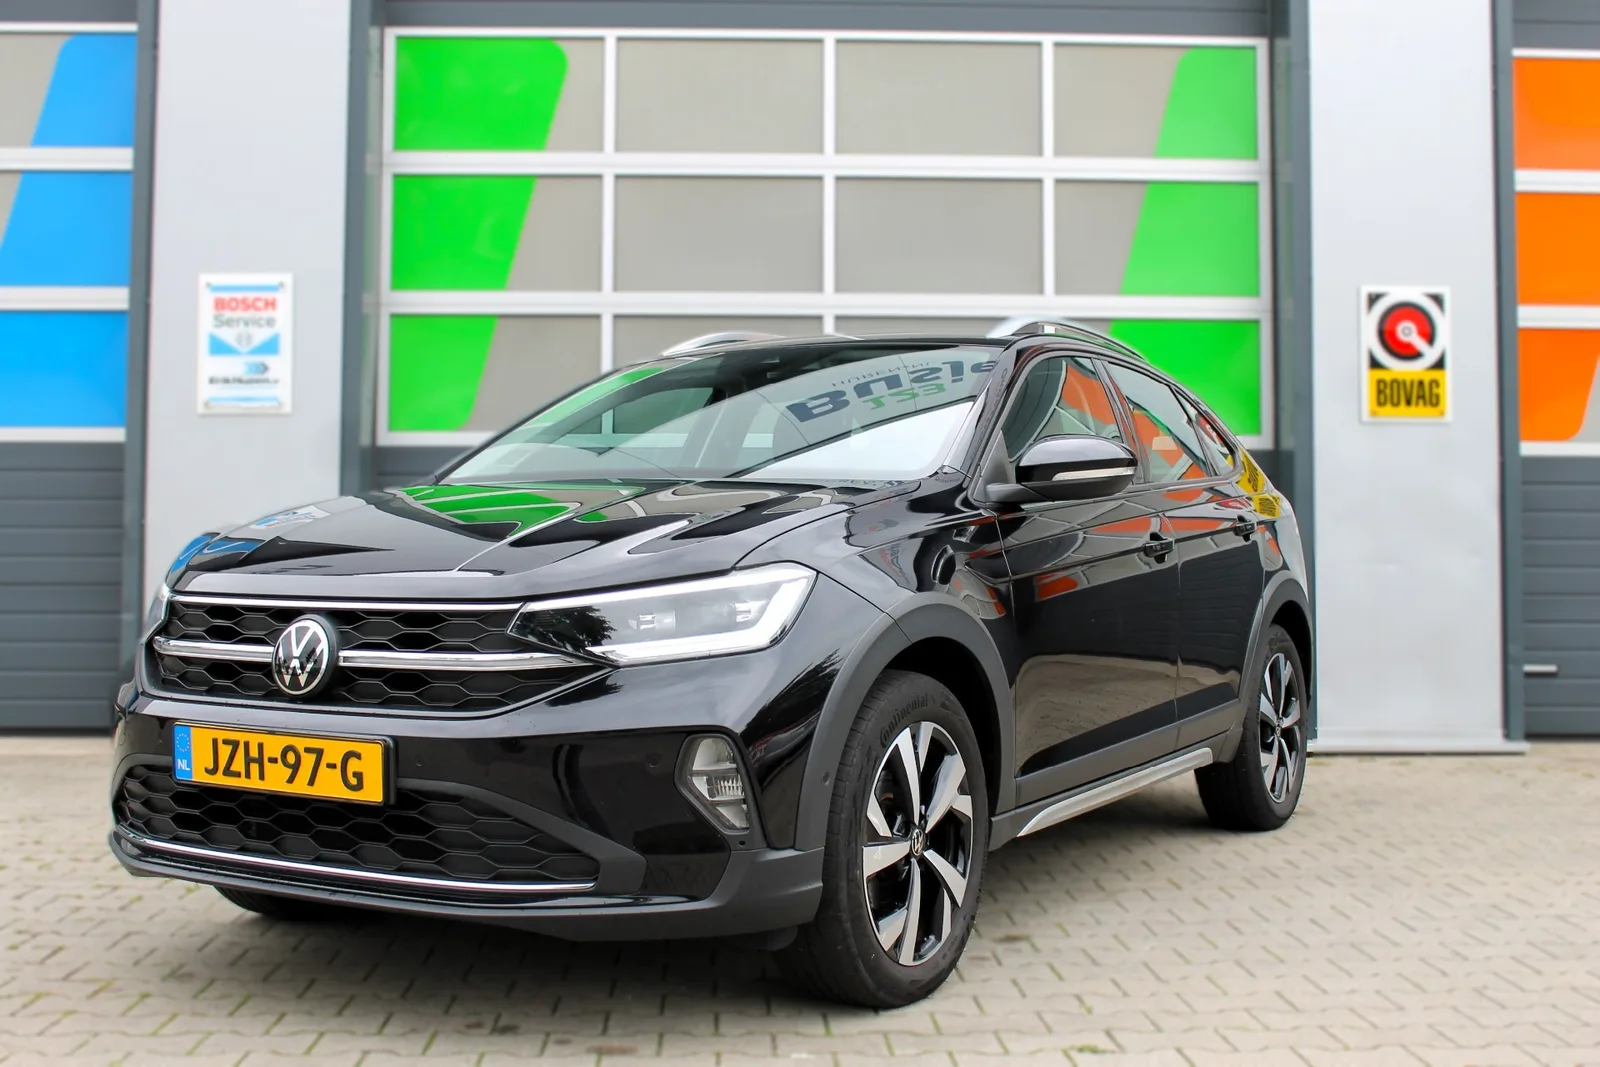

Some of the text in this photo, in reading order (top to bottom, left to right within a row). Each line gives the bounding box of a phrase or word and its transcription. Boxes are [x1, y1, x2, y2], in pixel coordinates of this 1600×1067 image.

[213, 296, 277, 312] BOSCH
[213, 314, 277, 328] Service
[1377, 378, 1440, 407] BOVAG
[880, 692, 928, 749] Continental
[178, 758, 191, 771] NL
[204, 737, 364, 792] JZH-97-G
